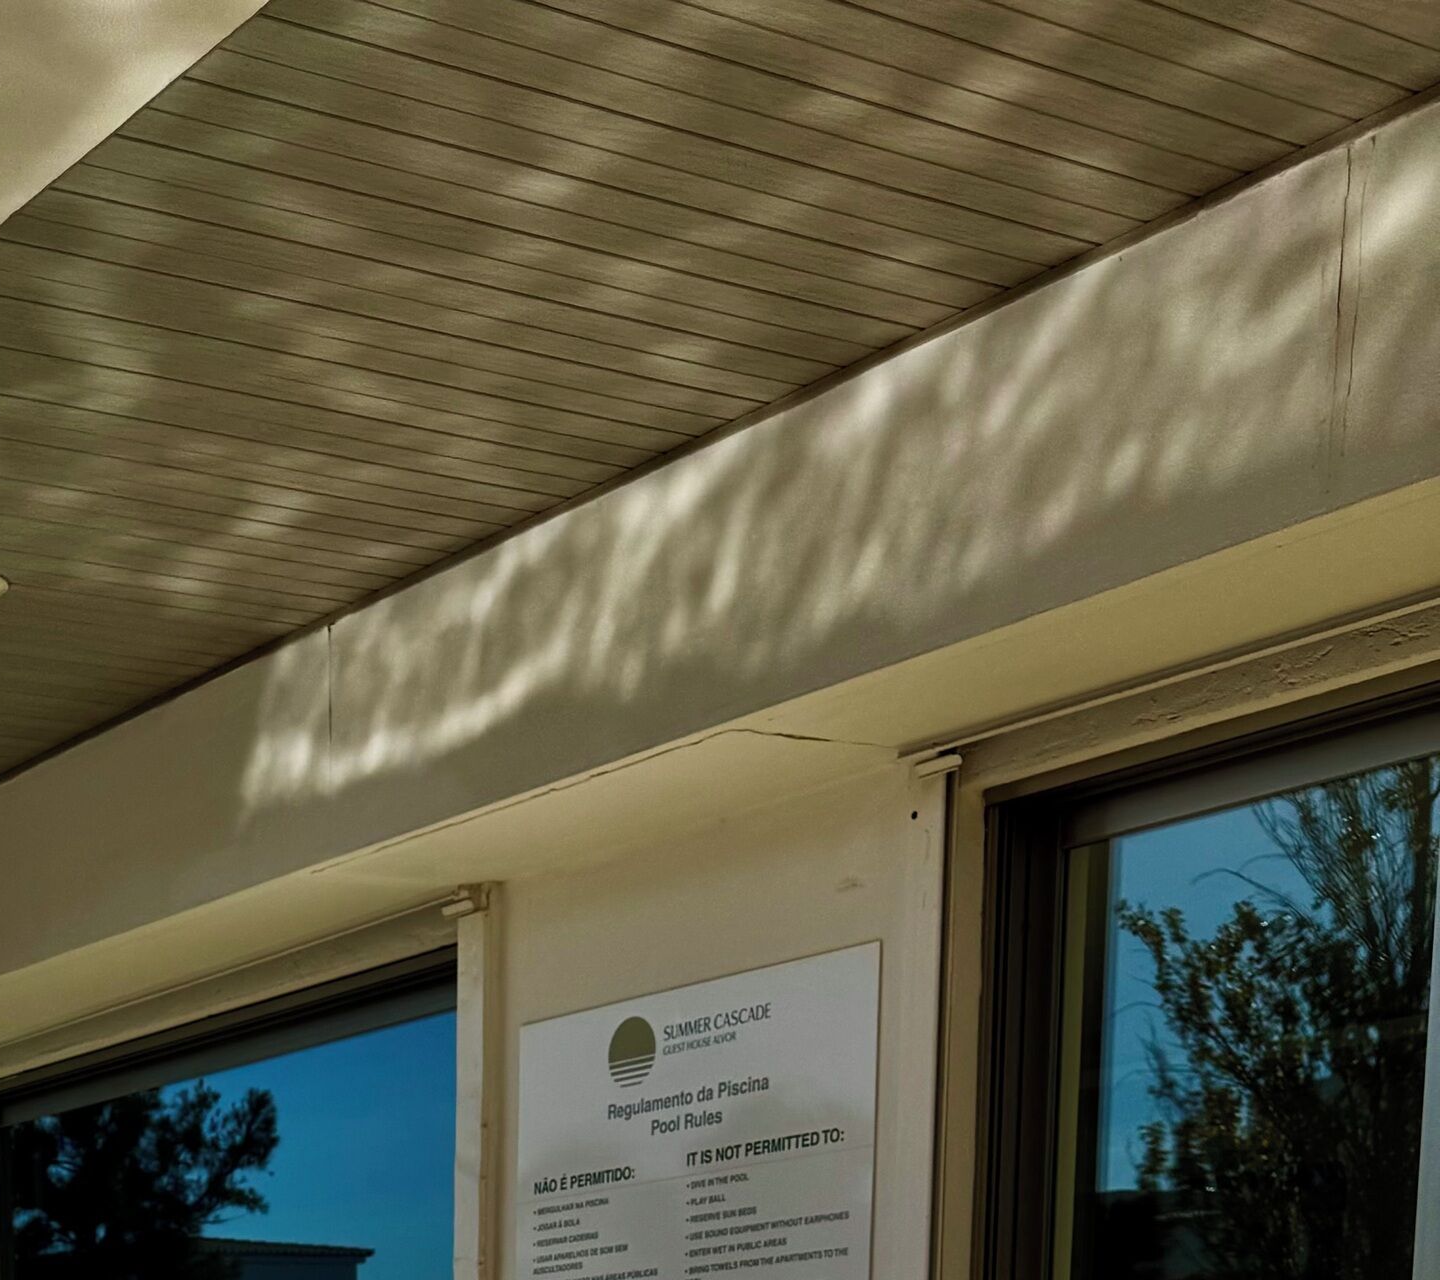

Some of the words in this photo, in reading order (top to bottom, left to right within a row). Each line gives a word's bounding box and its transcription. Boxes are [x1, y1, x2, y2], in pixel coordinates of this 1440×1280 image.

[663, 1016, 711, 1041] SUMMER
[713, 1002, 771, 1030] CASCADE
[662, 1041, 685, 1056] GUEST
[686, 1035, 711, 1051] HOUSE
[713, 1030, 737, 1045] ALVOR
[607, 1091, 693, 1120] Regulamento
[696, 1085, 714, 1103] da
[717, 1073, 769, 1098] Piscina
[650, 1115, 680, 1135] Pool
[683, 1107, 722, 1129] Rules
[686, 1151, 697, 1167] IT
[700, 1148, 712, 1165] IS
[715, 1144, 741, 1162] NOT
[744, 1130, 820, 1157] PERMITTED
[823, 1126, 844, 1144] TO:
[533, 1175, 557, 1195] NÃO
[559, 1173, 567, 1191] É
[569, 1165, 634, 1188] PERMITIDO:
[690, 1179, 706, 1189] DIVE
[707, 1178, 714, 1186] IN
[715, 1175, 728, 1185] THE
[729, 1172, 748, 1183] POOL
[690, 1196, 707, 1206] PLAY
[708, 1194, 725, 1203] BALL
[688, 1264, 709, 1274] BRING
[710, 1261, 738, 1271] TOWELS
[739, 1258, 759, 1268] FROM
[760, 1256, 773, 1265] THE
[775, 1250, 823, 1263] APARTMENTS
[823, 1249, 833, 1258] TO
[834, 1247, 848, 1256] THE
[689, 1247, 711, 1257] ENTER
[712, 1245, 726, 1254] WET
[727, 1244, 735, 1252] IN
[736, 1240, 762, 1251] PUBLIC
[763, 1237, 787, 1248] AREAS
